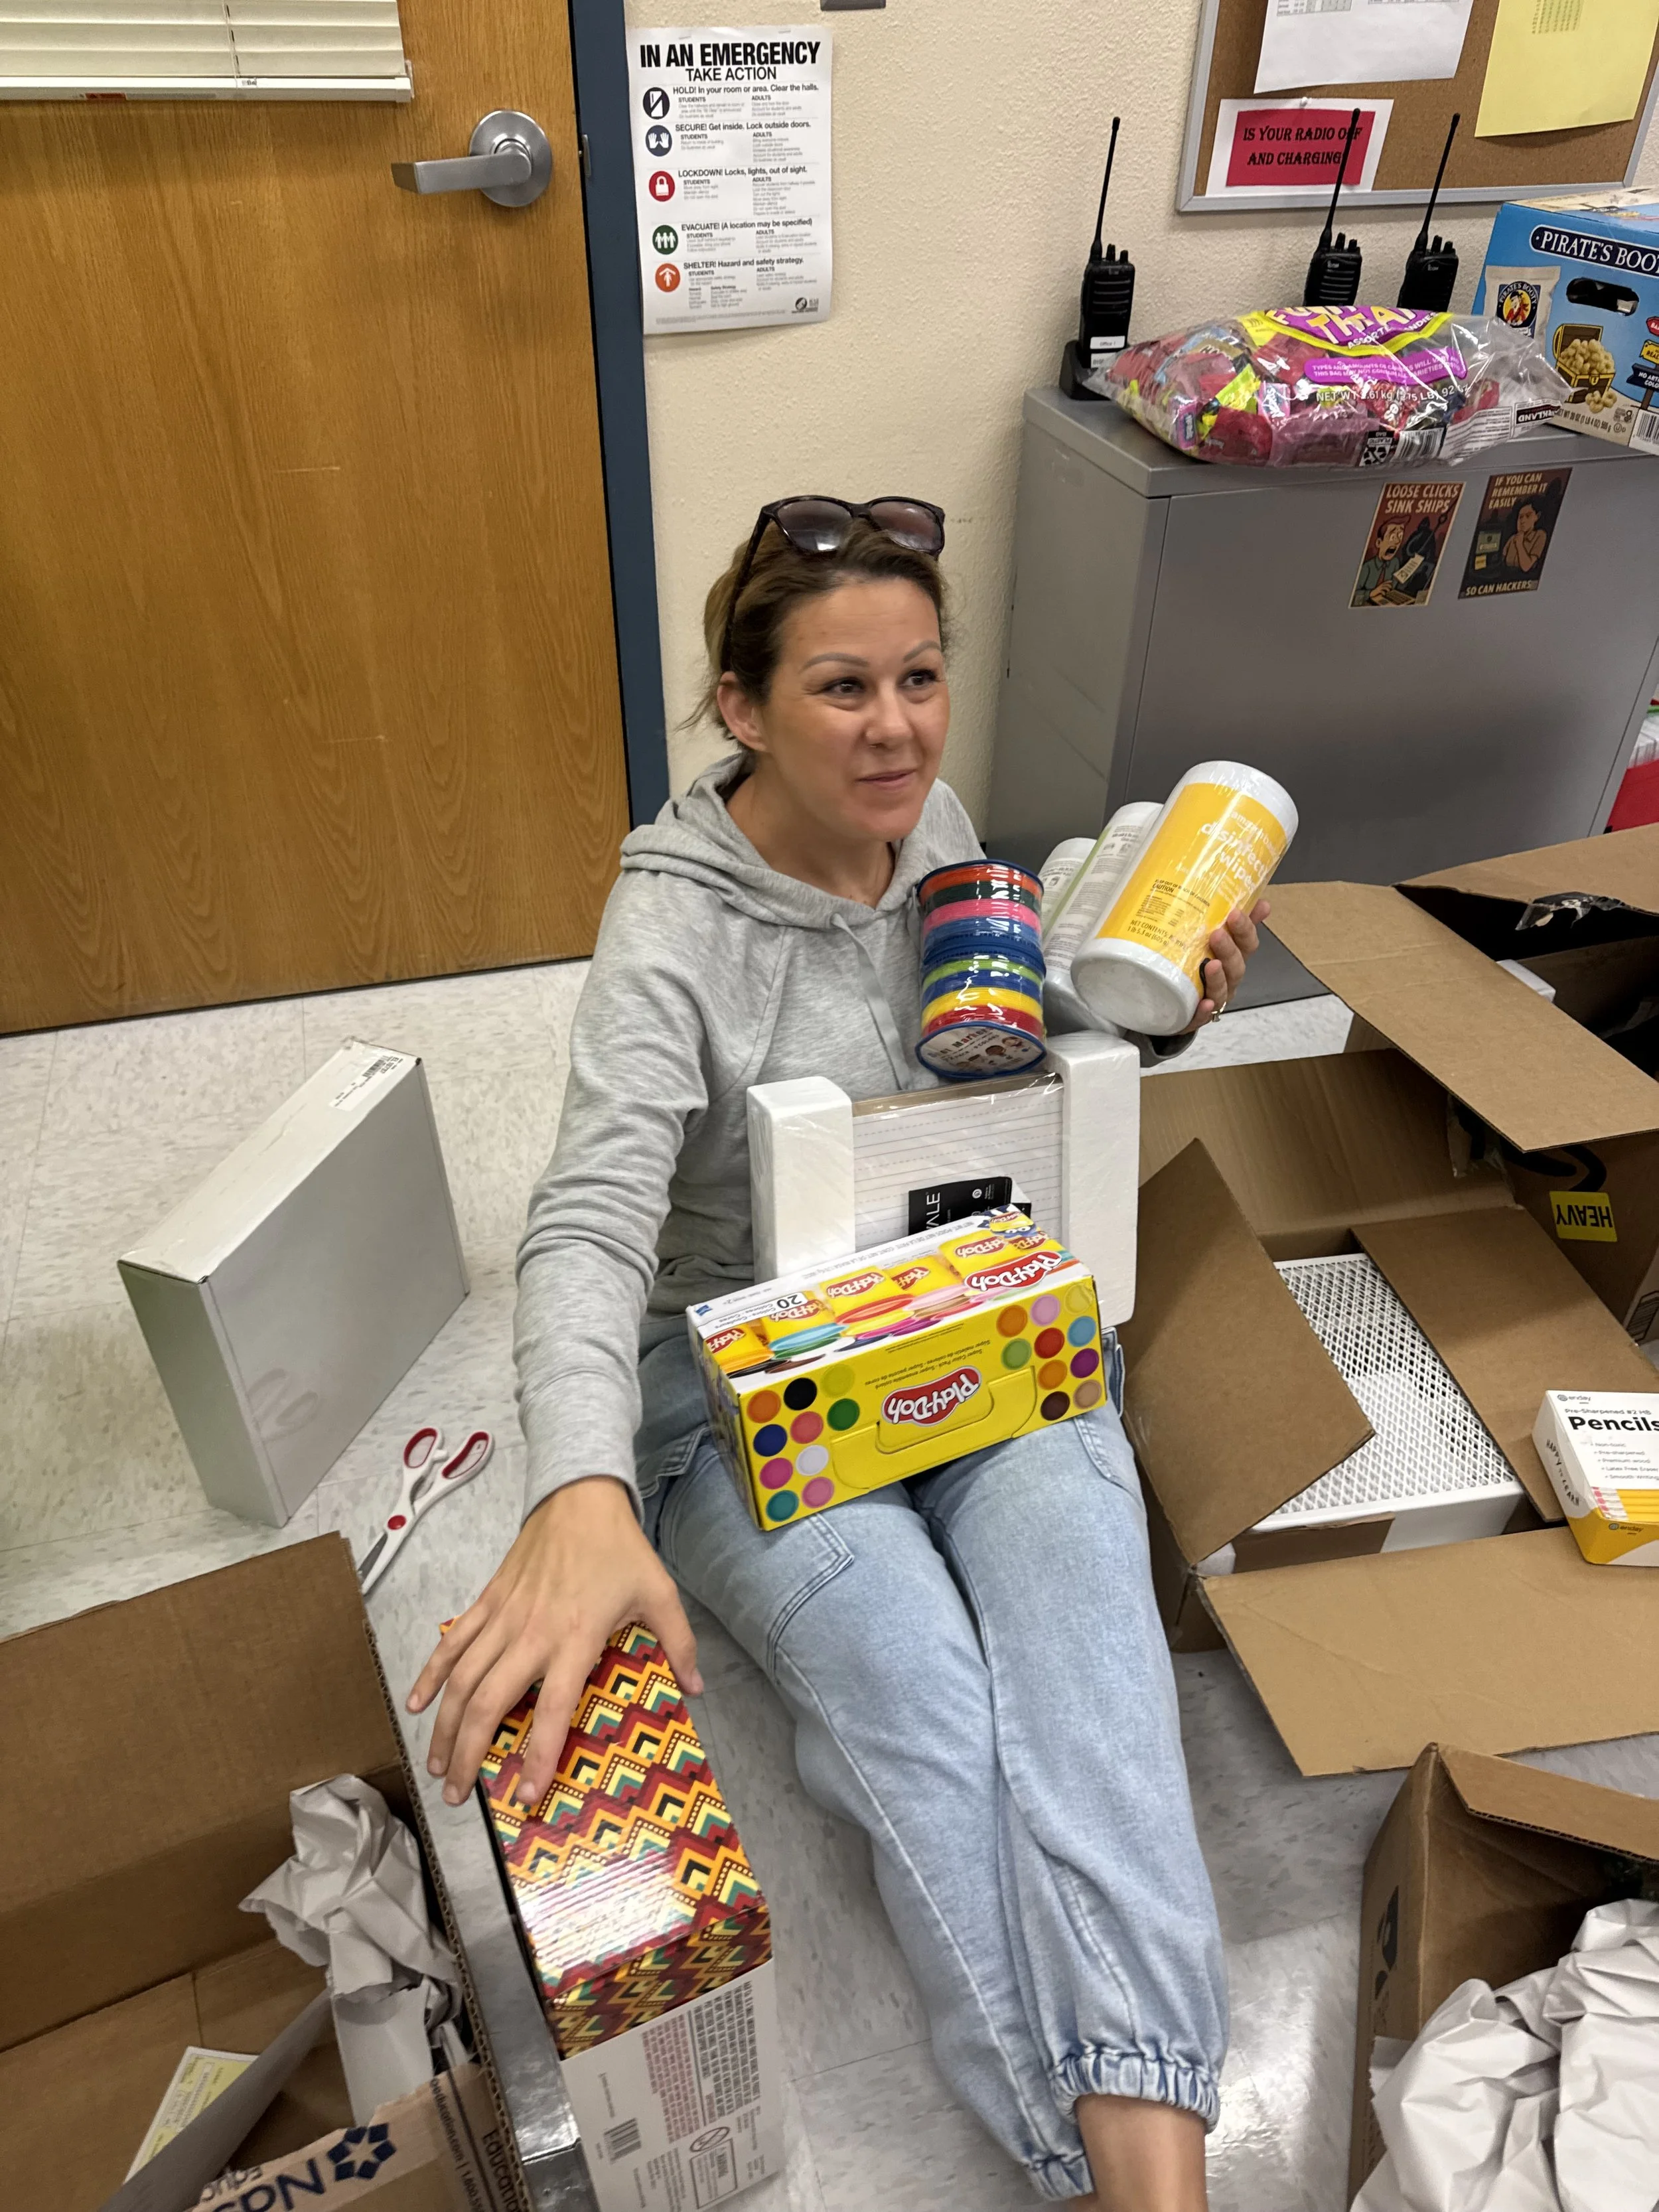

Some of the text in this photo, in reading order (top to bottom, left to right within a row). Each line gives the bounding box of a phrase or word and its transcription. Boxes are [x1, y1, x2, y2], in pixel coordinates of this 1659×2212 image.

[640, 41, 821, 67] IN AN EMERGENCY
[685, 67, 776, 82] TAKE ACTION
[1244, 125, 1335, 141] IS YOUR RADIO
[1248, 152, 1274, 165] AND
[725, 168, 747, 177] Locks,
[790, 166, 808, 175] sight.
[682, 222, 719, 231] EVACUATE!
[721, 222, 729, 231] (A
[782, 218, 813, 227] specified)
[1540, 231, 1613, 262] PIRATE'S
[1522, 283, 1538, 304] BOOTY
[1348, 324, 1393, 348] ASSORTE
[1414, 358, 1431, 370] WILL
[1317, 392, 1337, 402] NET
[1381, 391, 1393, 400] kg
[1442, 386, 1455, 397] 92
[1494, 473, 1542, 486] IF YOU CAN
[1386, 482, 1460, 498] LOOSE CLICKS
[1492, 482, 1548, 498] REMEMBER IT
[1385, 499, 1450, 514] SINK SHIPS
[1489, 497, 1516, 510] EASILY
[1466, 580, 1533, 596] SO CAN HACKERS
[1152, 883, 1175, 893] CAUTION
[1139, 921, 1168, 938] CONTENTS:
[1151, 932, 1163, 944] (605
[952, 1027, 993, 1048] Marker
[1556, 1204, 1613, 1228] HEAVY
[972, 1254, 1062, 1291] Play-Doh
[827, 1272, 885, 1297] Play-Doh
[776, 1294, 802, 1308] 20
[952, 1353, 966, 1362] Color
[968, 1349, 983, 1357] Super
[887, 1373, 980, 1424] Play-Doh
[1546, 1438, 1580, 1507] HAPPY LEARN
